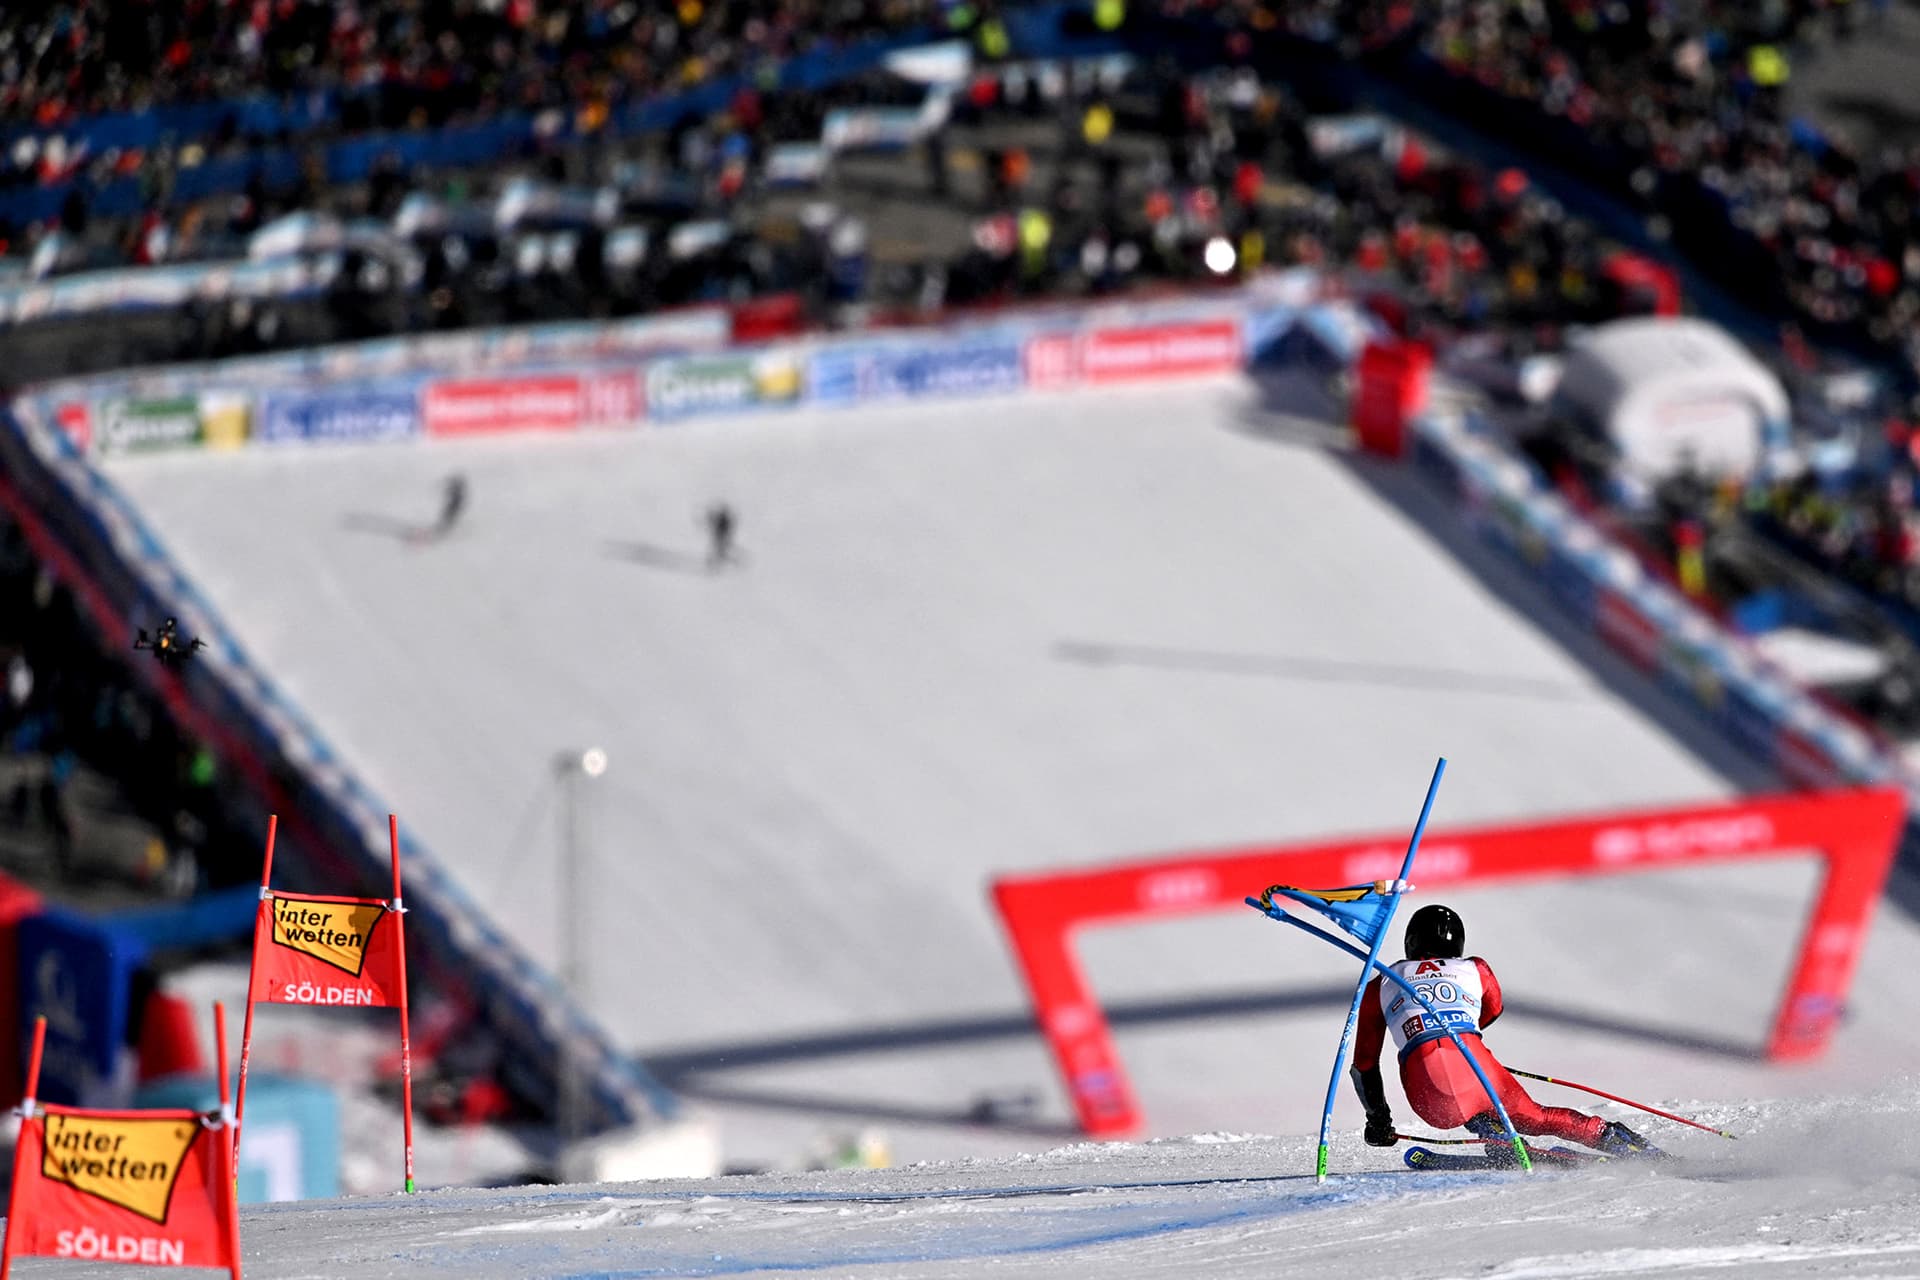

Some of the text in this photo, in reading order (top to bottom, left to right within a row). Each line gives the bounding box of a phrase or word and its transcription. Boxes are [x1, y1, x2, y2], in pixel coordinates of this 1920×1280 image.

[280, 900, 332, 927] inter
[286, 928, 362, 947] wetten
[1415, 959, 1446, 974] A1
[284, 981, 372, 1005] SÖLDEN
[1411, 983, 1457, 1005] 60
[54, 1115, 125, 1151] inter
[61, 1157, 168, 1182] wetten
[56, 1226, 184, 1265] SÖLDEN
